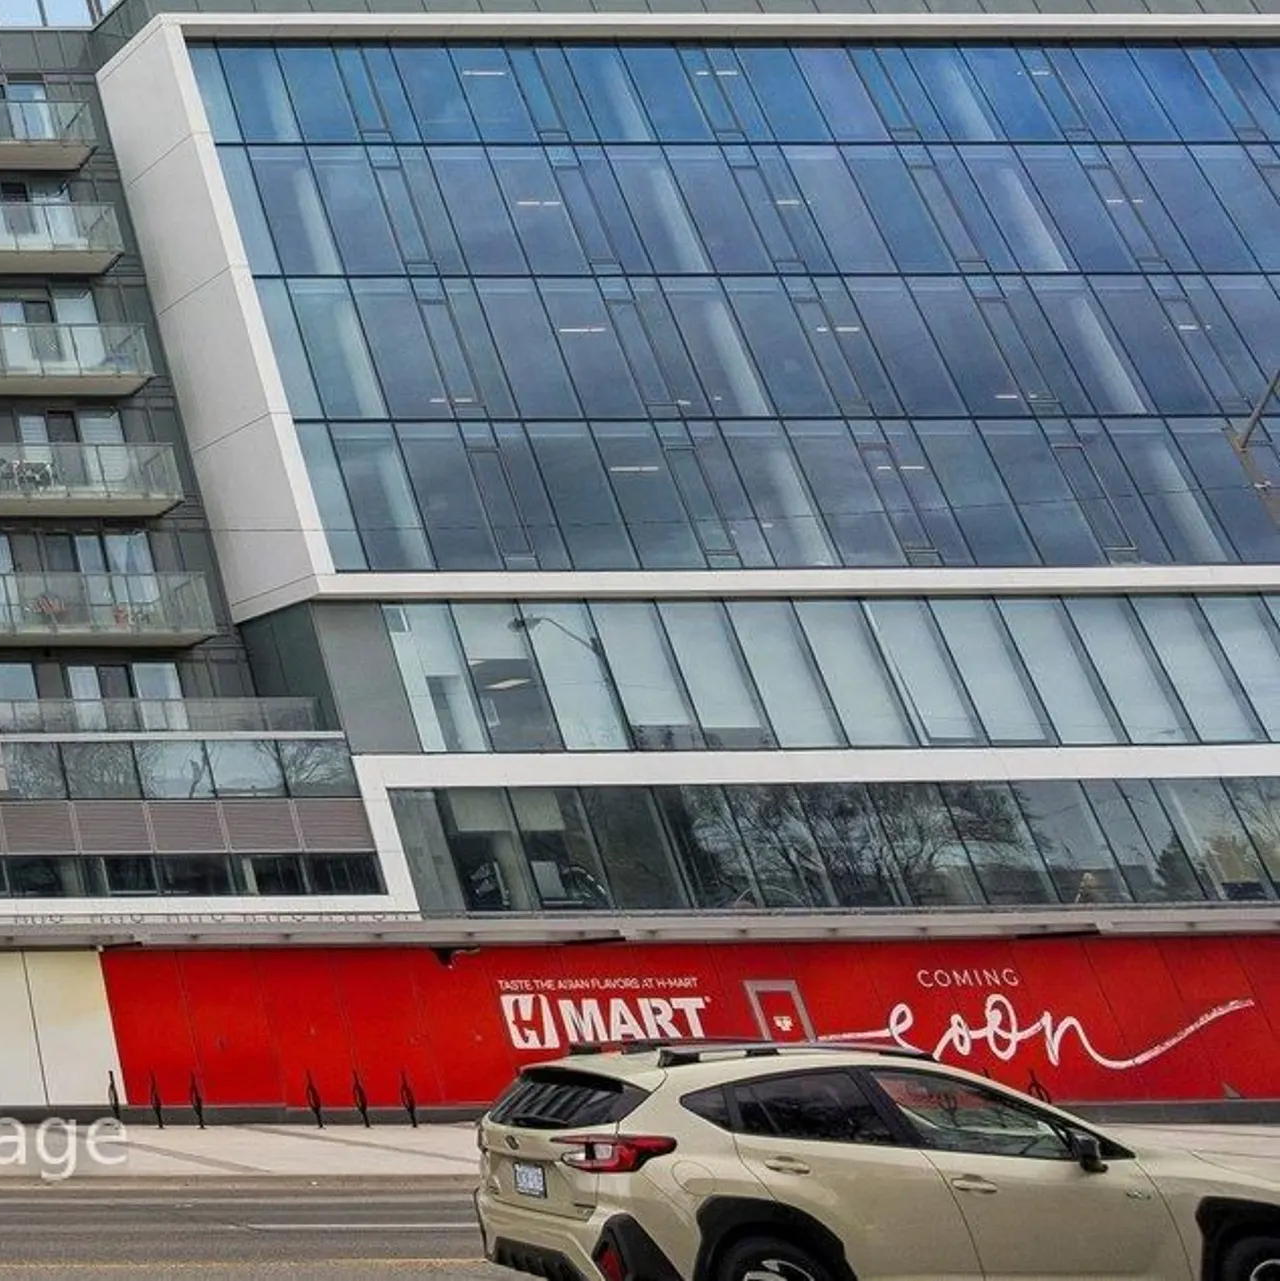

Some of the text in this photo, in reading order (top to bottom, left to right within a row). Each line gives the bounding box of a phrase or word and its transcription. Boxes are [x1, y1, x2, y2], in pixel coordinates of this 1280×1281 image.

[498, 978, 534, 991] TASTE
[533, 978, 557, 991] THE
[590, 977, 641, 990] FLAVORS
[917, 968, 1019, 988] COMING
[557, 996, 707, 1043] MART
